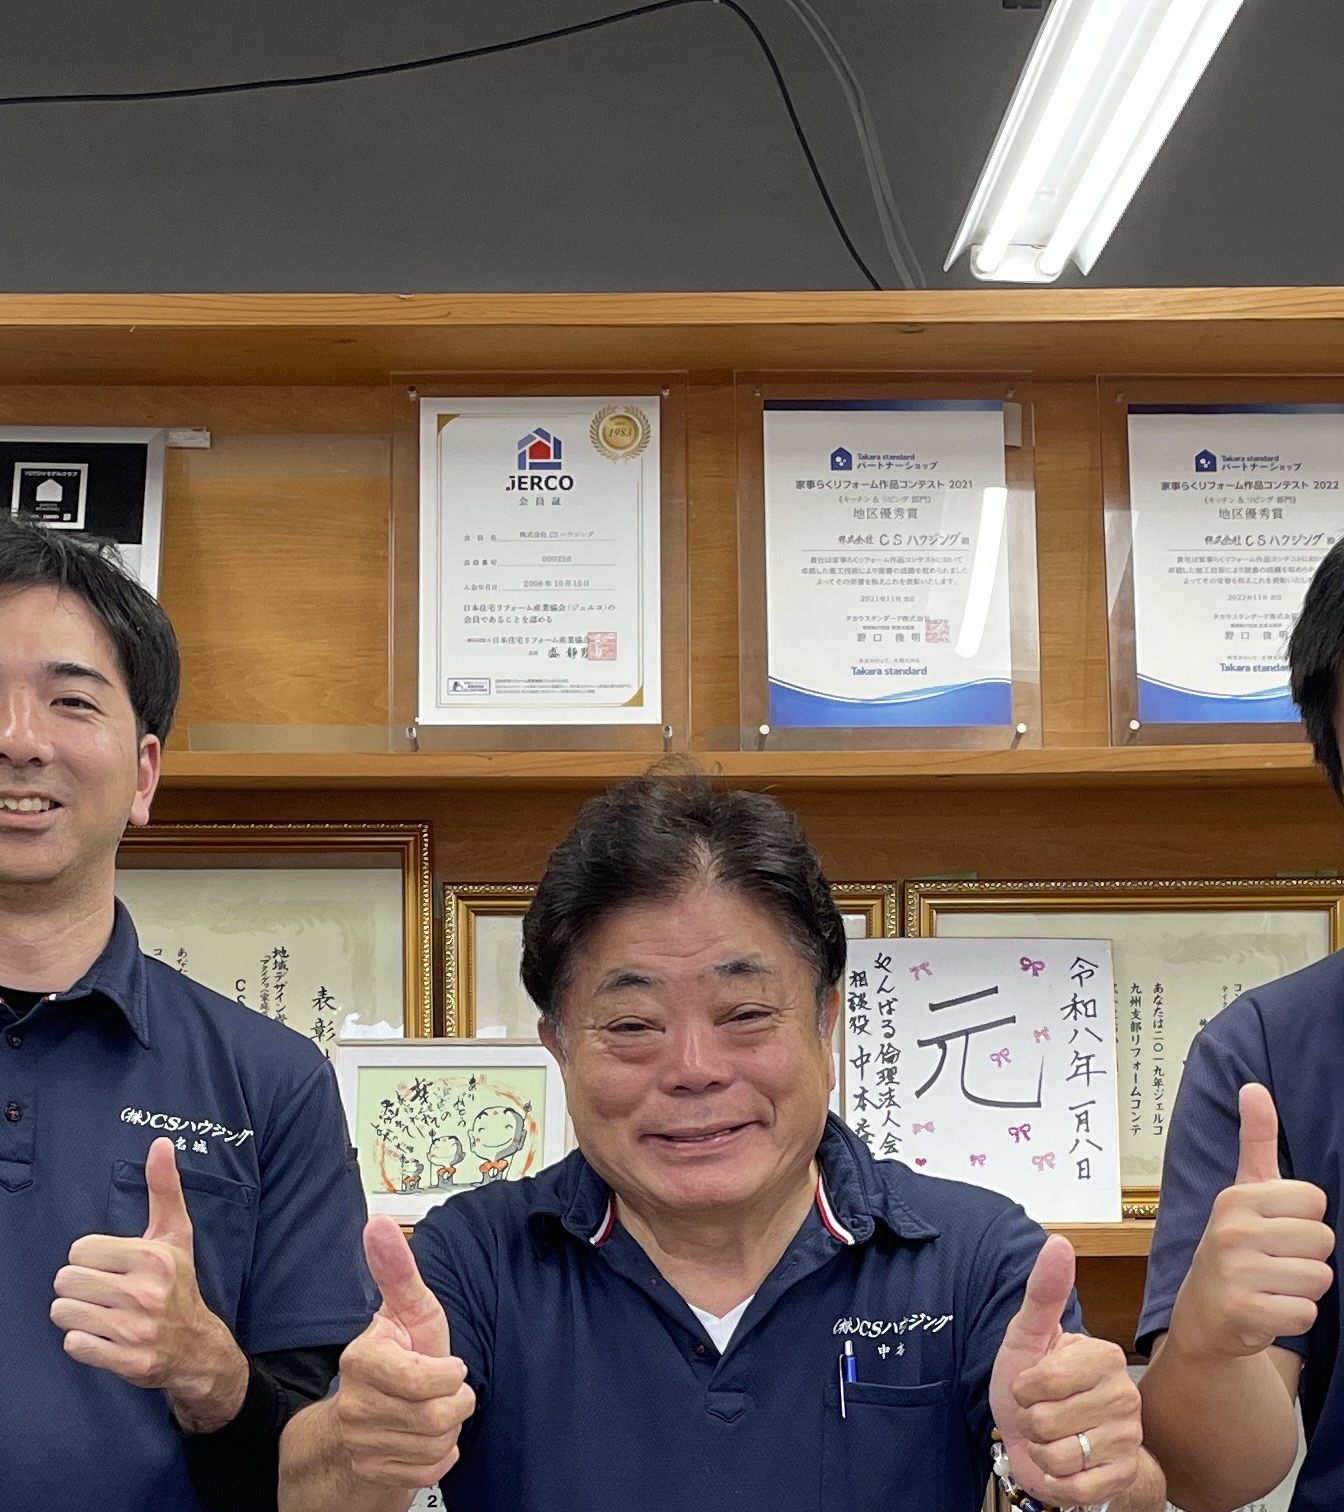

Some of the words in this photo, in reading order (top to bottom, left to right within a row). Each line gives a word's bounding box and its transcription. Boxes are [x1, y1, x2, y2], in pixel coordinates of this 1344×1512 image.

[608, 428, 633, 437] 1983
[857, 461, 938, 470] パートナーショップ
[1221, 462, 1302, 471] パートナーショップ
[506, 475, 574, 491] JERCO
[795, 480, 945, 490] 家事らくリフォーム作品コンテスト
[949, 480, 974, 489] 2021
[1161, 481, 1309, 490] 家事らくリフォーム作品コンテスト
[1313, 481, 1339, 490] 2022
[853, 508, 919, 520] 地区優秀賞
[1219, 508, 1284, 520] 地区優秀賞
[851, 666, 883, 675] Takara
[884, 666, 928, 675] standard
[1220, 663, 1251, 672] Takara
[847, 970, 872, 1036] 相談役
[310, 986, 337, 1059] 表彰
[874, 952, 902, 1156] やんばる倫理法人会
[915, 985, 1044, 1109] 元
[1130, 982, 1143, 1136] 九州支部リフォームコンテ
[1152, 982, 1165, 1135] あなたは二〇一九年ジェルコ
[1060, 956, 1107, 1180] 令和八年一月八日
[120, 1107, 254, 1147] (株)CSハウジング
[427, 1494, 438, 1508] 2
